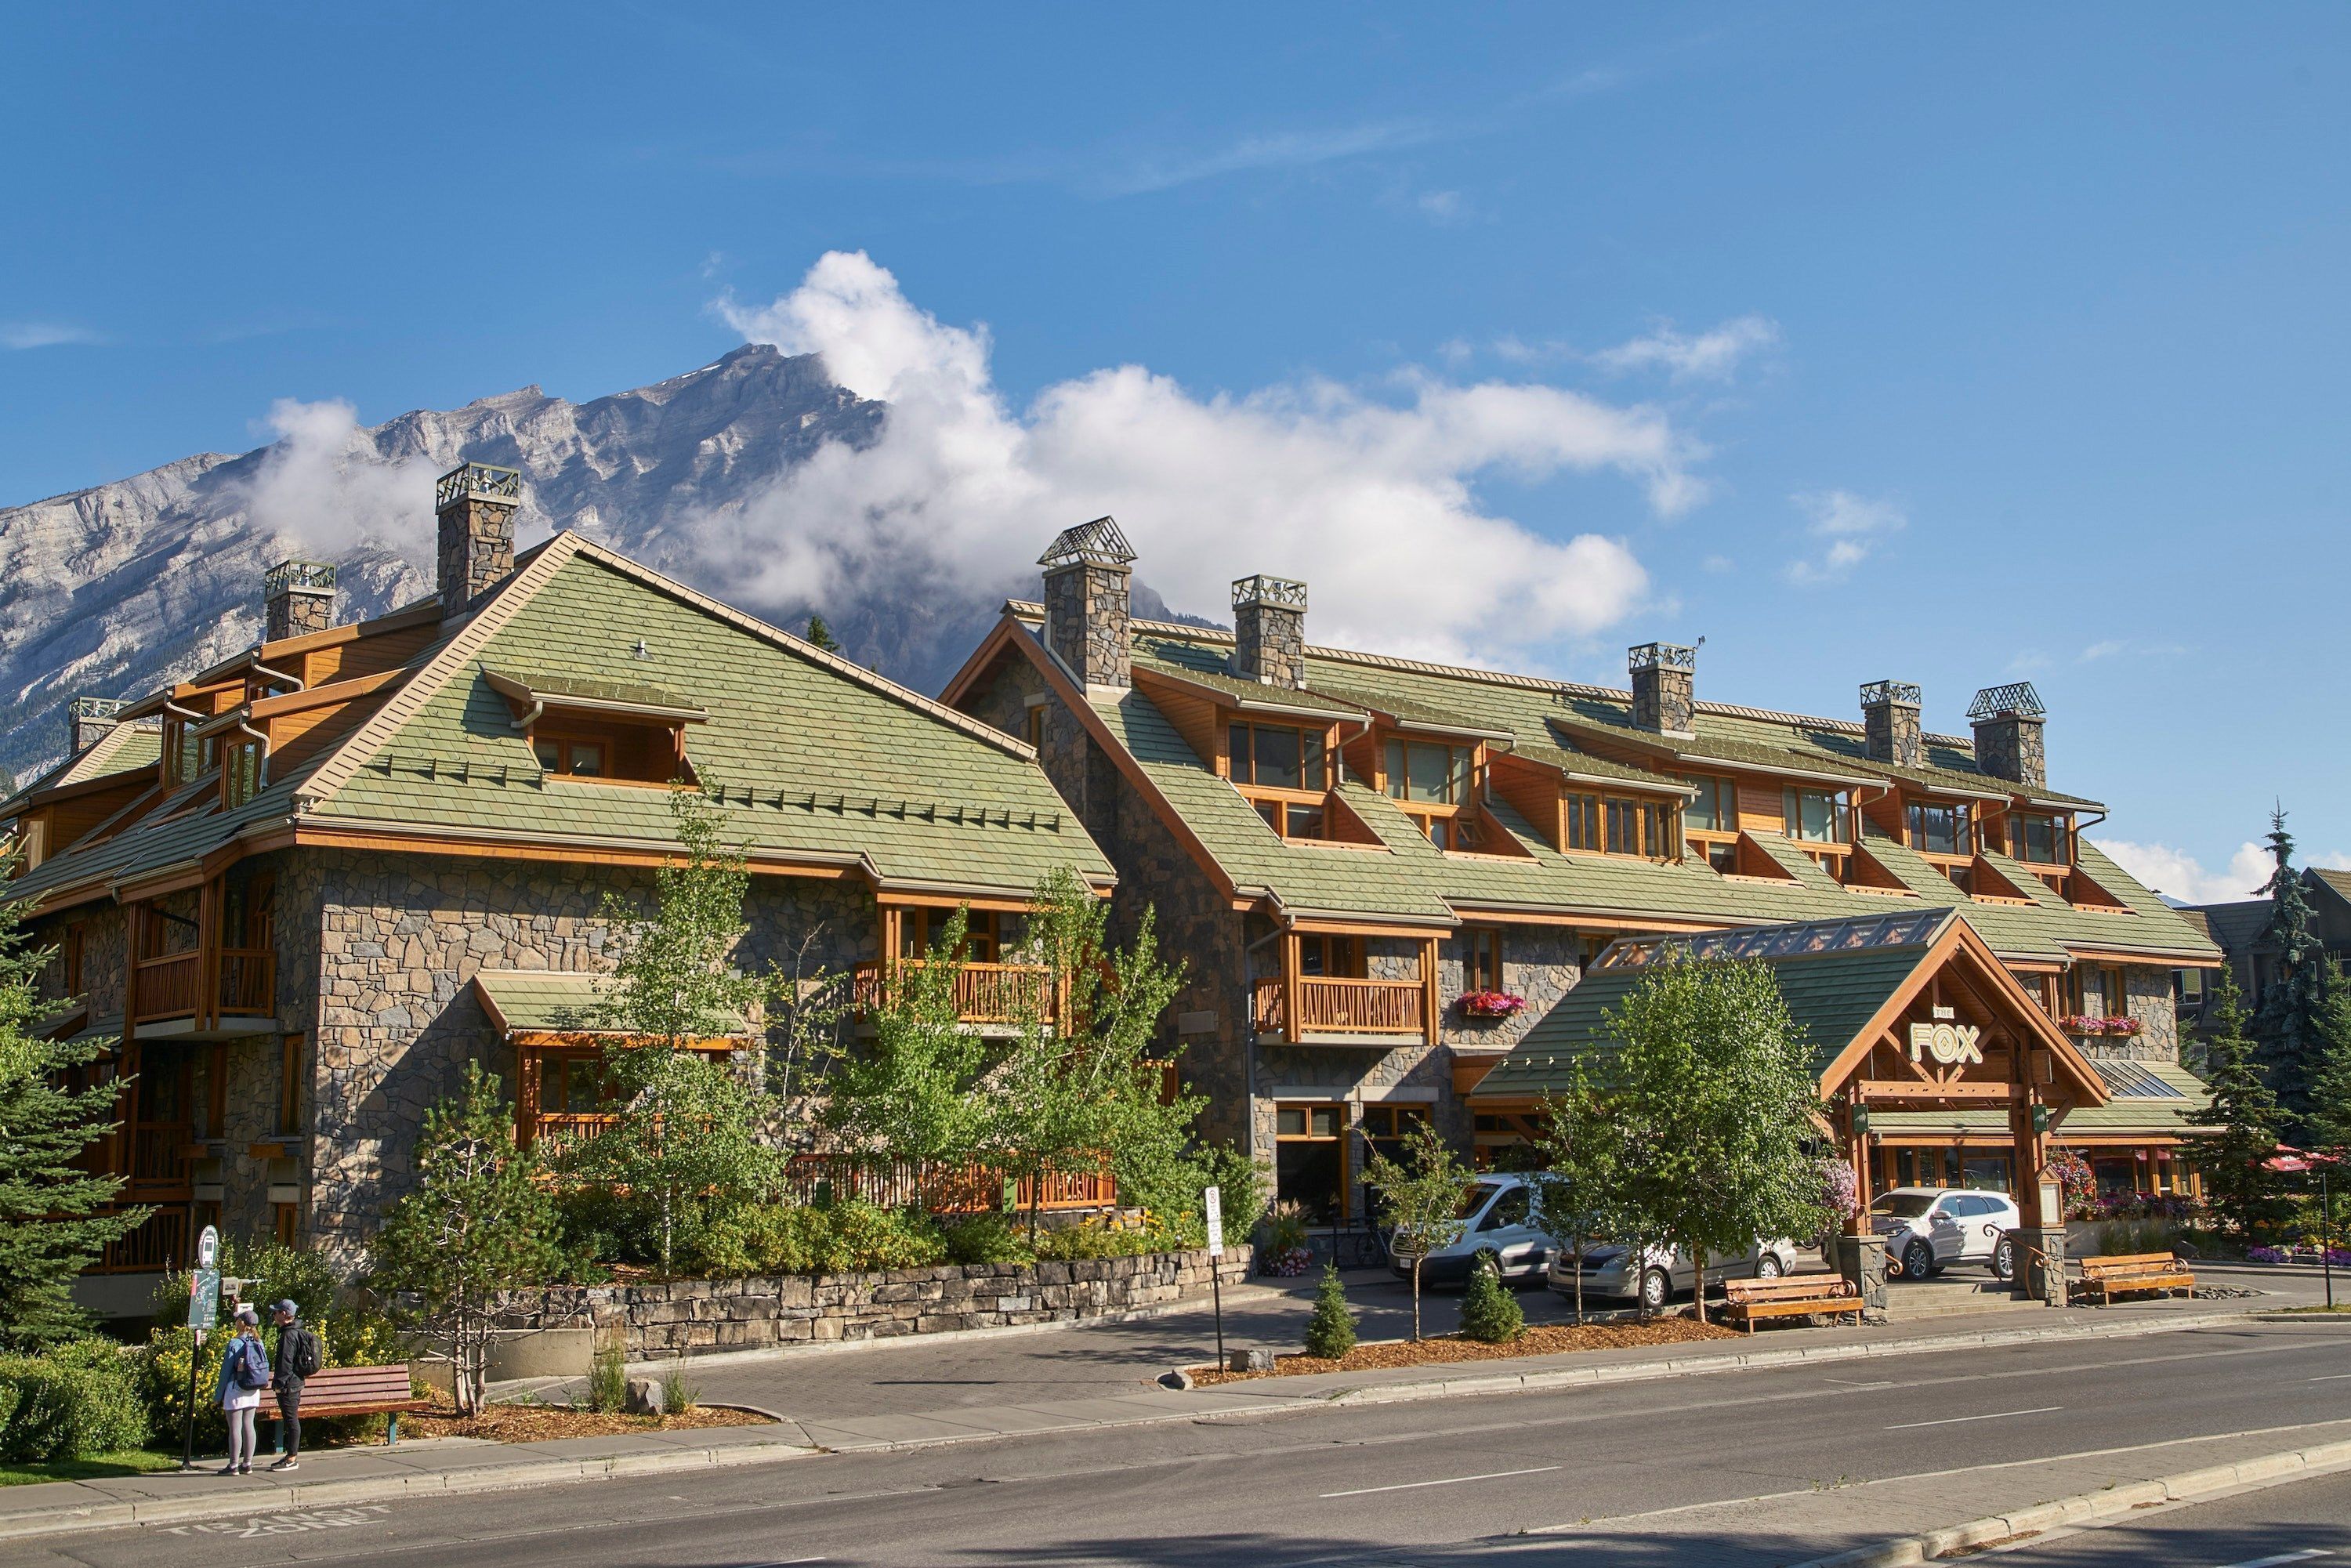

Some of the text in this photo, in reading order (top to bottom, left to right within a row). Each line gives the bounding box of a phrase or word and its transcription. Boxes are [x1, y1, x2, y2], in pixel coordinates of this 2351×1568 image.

[1935, 1009, 1951, 1017] THE
[1910, 1022, 1983, 1064] FOX
[156, 1505, 393, 1536] TRANSIT
[223, 1516, 388, 1538] ZONE
